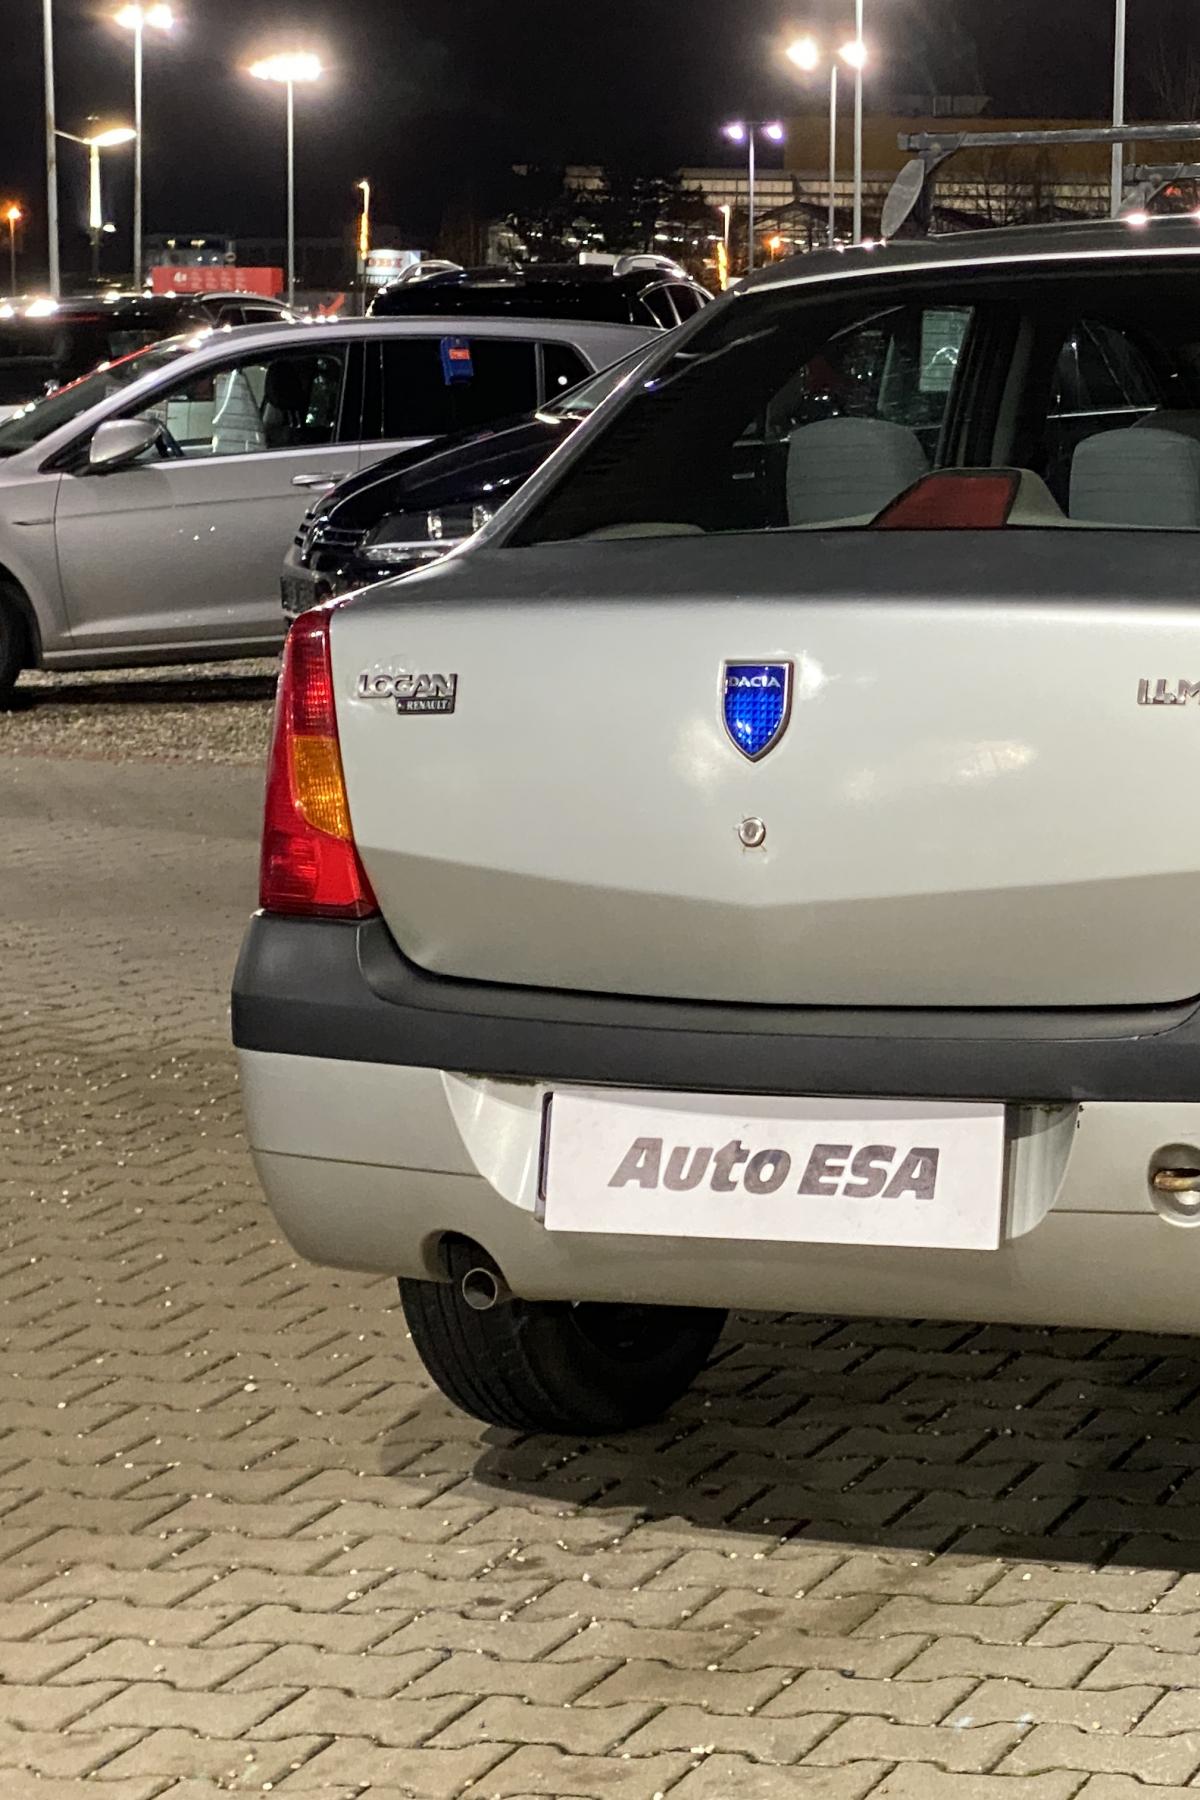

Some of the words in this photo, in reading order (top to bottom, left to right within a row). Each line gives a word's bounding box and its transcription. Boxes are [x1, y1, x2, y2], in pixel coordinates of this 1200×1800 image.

[358, 673, 458, 699] LOGAN
[727, 676, 781, 687] DACIA
[406, 700, 449, 711] RENAULT
[607, 1137, 792, 1195] Auto
[797, 1144, 940, 1200] ESA
